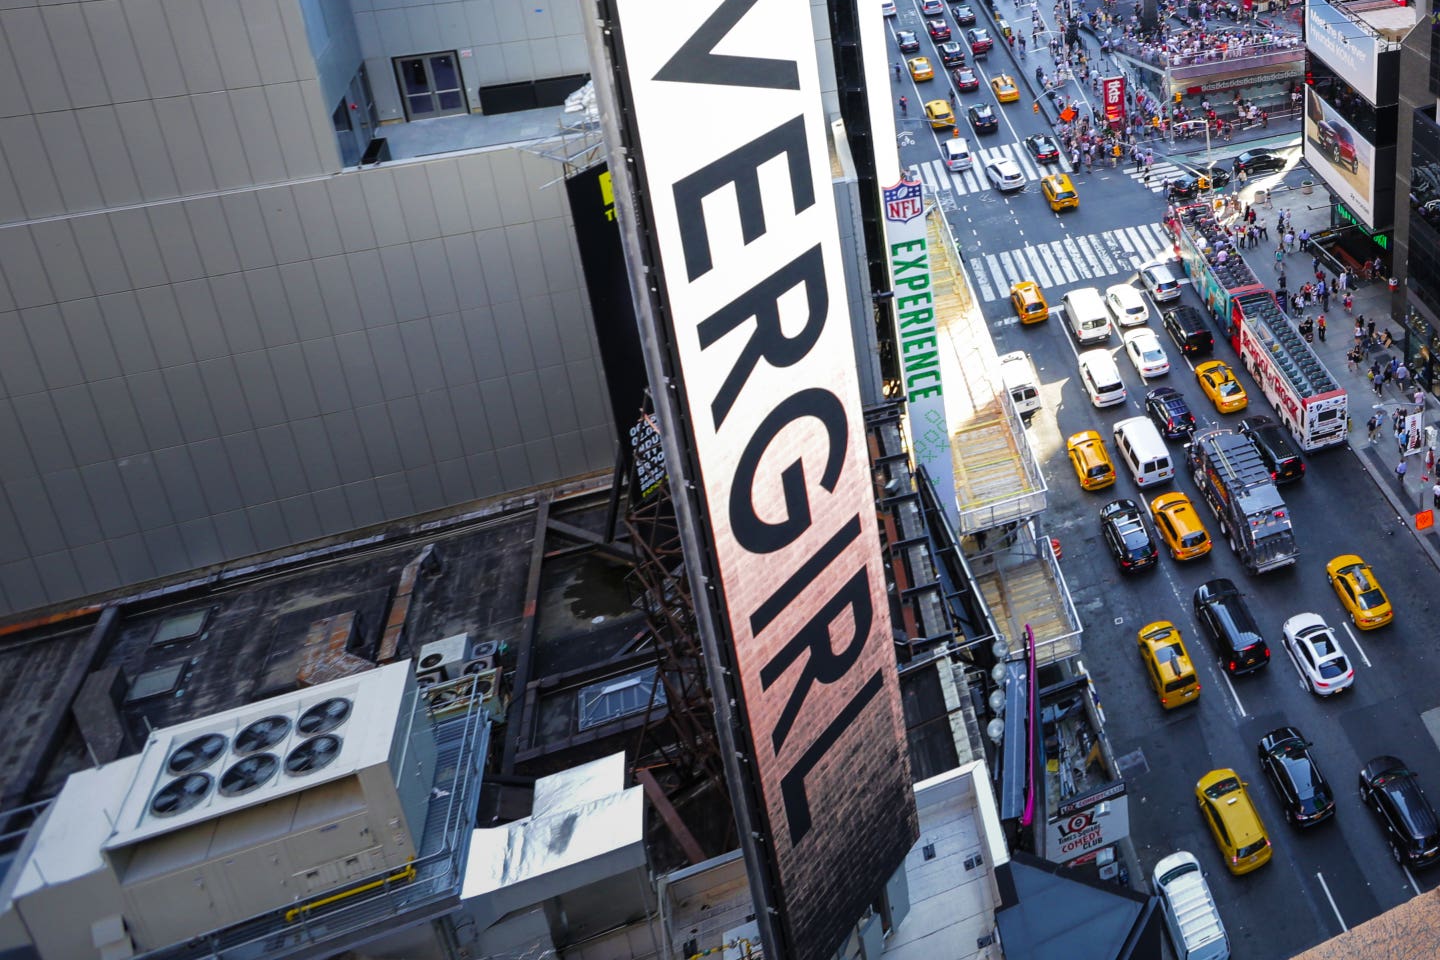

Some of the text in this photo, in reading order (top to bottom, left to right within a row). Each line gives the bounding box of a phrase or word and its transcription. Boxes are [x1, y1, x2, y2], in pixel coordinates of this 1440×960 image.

[1310, 9, 1326, 28] Meet
[1108, 81, 1120, 104] tkts
[888, 198, 921, 220] NFL
[890, 238, 942, 403] EXPERIENCE
[1242, 330, 1269, 374] SCHOOL
[1274, 377, 1298, 415] ROCK
[1059, 823, 1101, 845] TIMES SQUARE
[1062, 830, 1102, 854] COMEDY
[1082, 836, 1103, 850] CLUB
